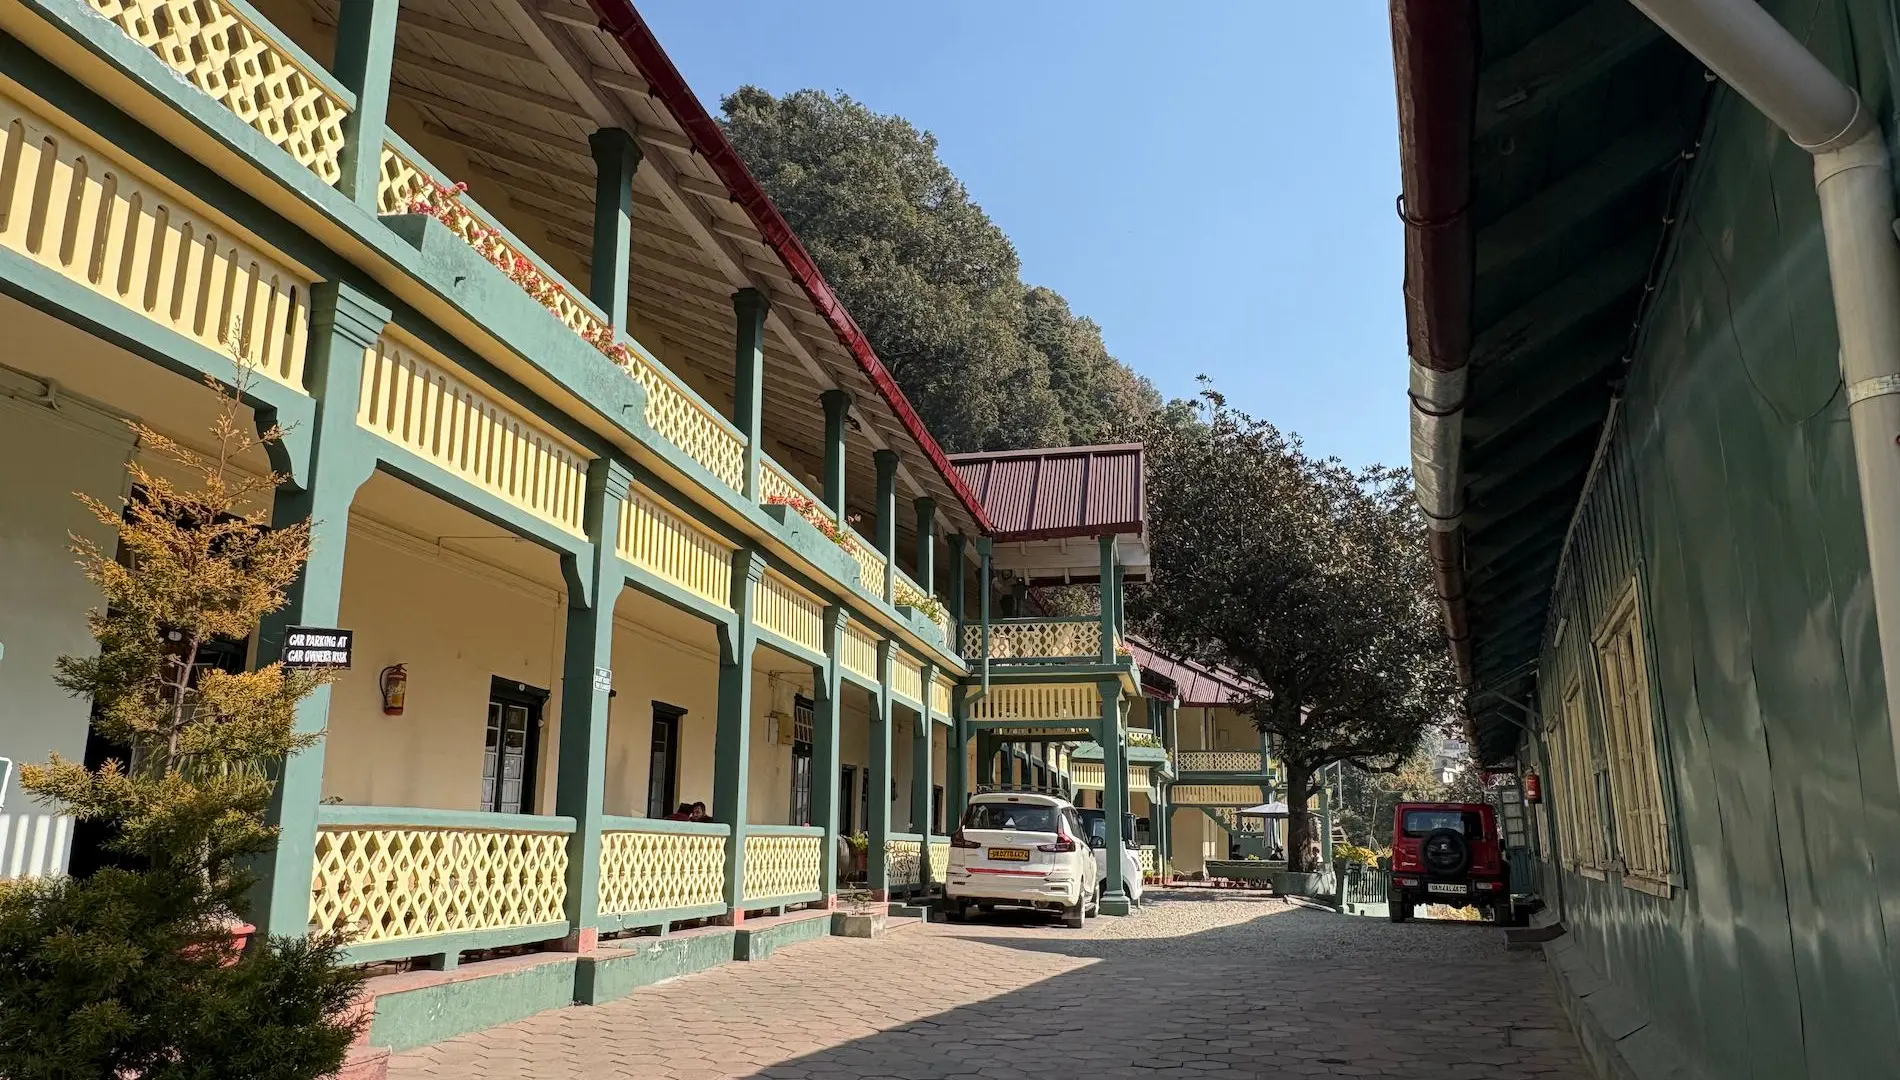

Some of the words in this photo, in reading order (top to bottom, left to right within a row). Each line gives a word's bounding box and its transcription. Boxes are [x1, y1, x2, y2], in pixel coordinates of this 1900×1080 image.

[289, 634, 305, 646] CAR
[305, 634, 336, 648] PARKING
[337, 636, 348, 648] AT
[287, 650, 304, 662] CAR
[331, 651, 347, 663] RISK
